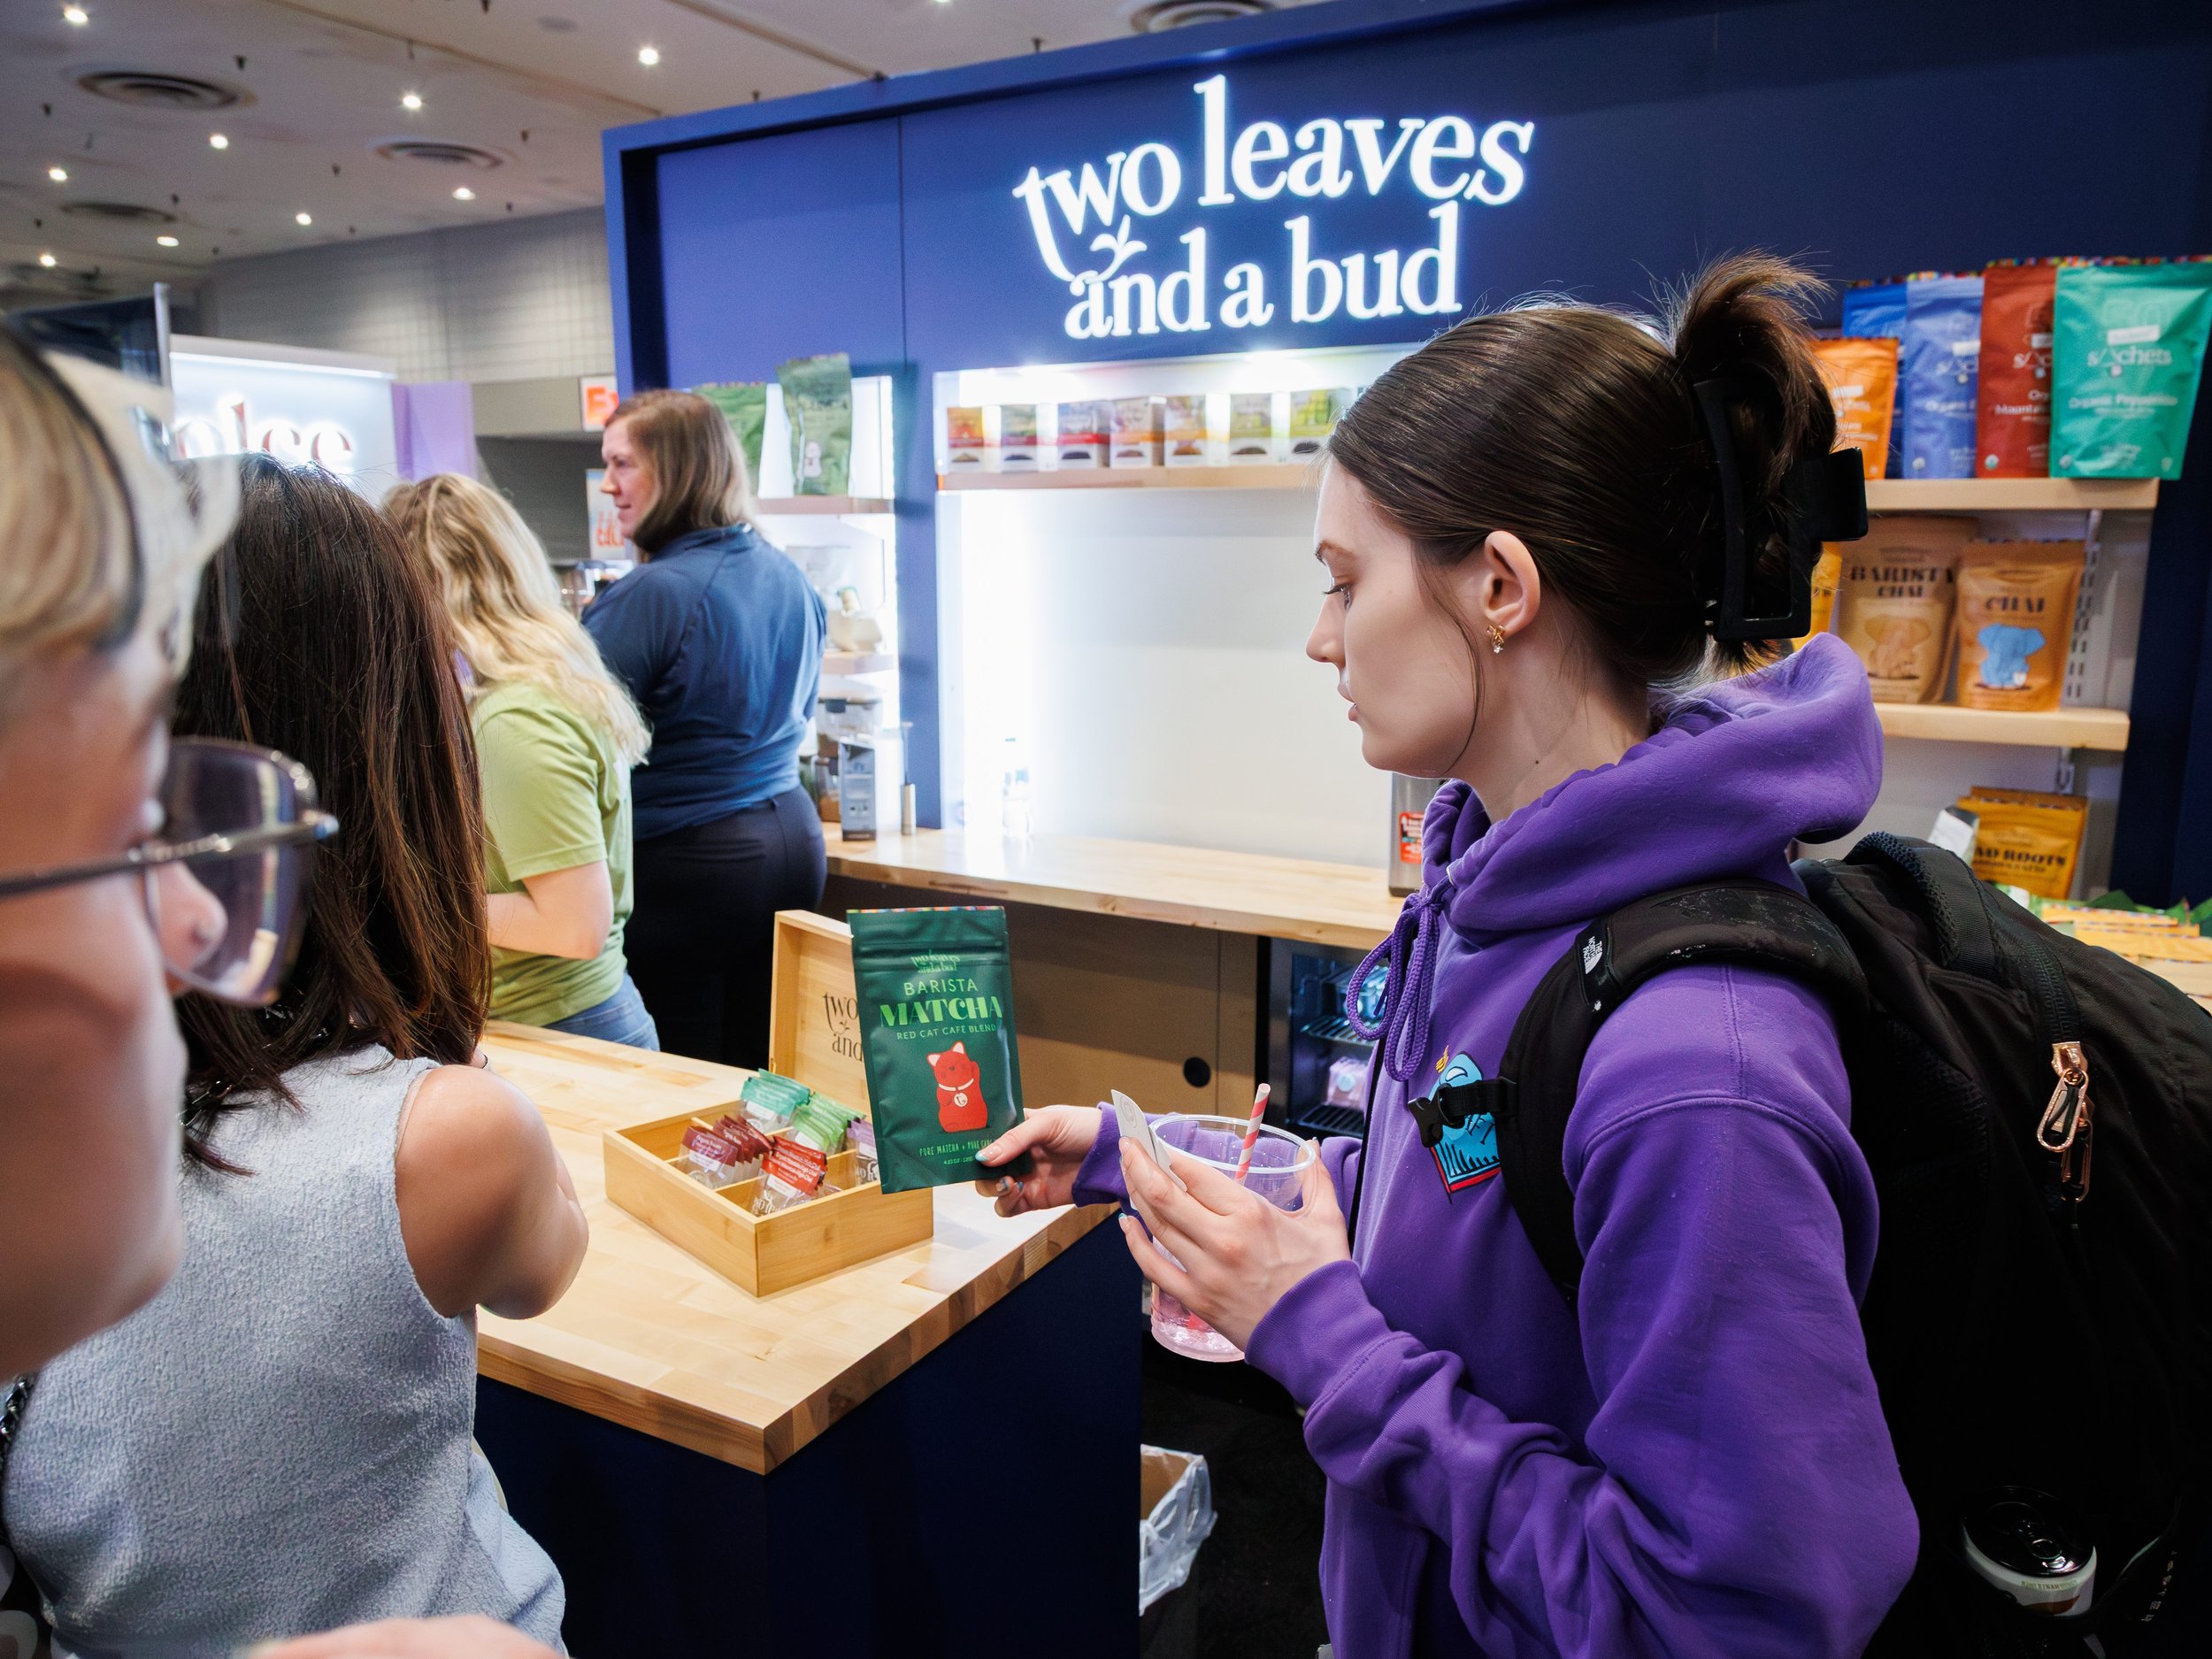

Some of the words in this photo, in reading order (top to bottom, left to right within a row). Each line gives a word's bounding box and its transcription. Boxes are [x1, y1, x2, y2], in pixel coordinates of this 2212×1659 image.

[1011, 142, 1181, 281] two
[1193, 73, 1535, 206] leaves
[1064, 227, 1211, 340] and
[1218, 263, 1275, 328] a
[1284, 200, 1463, 324] bud
[1985, 596, 2045, 613] CHAI
[903, 978, 979, 996] BARISTA
[822, 992, 858, 1035] two
[879, 995, 1003, 1027] MATCHA
[896, 1031, 917, 1041] RED
[919, 1028, 938, 1039] CAT
[941, 1025, 966, 1036] CAFE
[969, 1024, 997, 1033] BLEND
[919, 1146, 934, 1156] PURE
[936, 1142, 960, 1155] MATCHA
